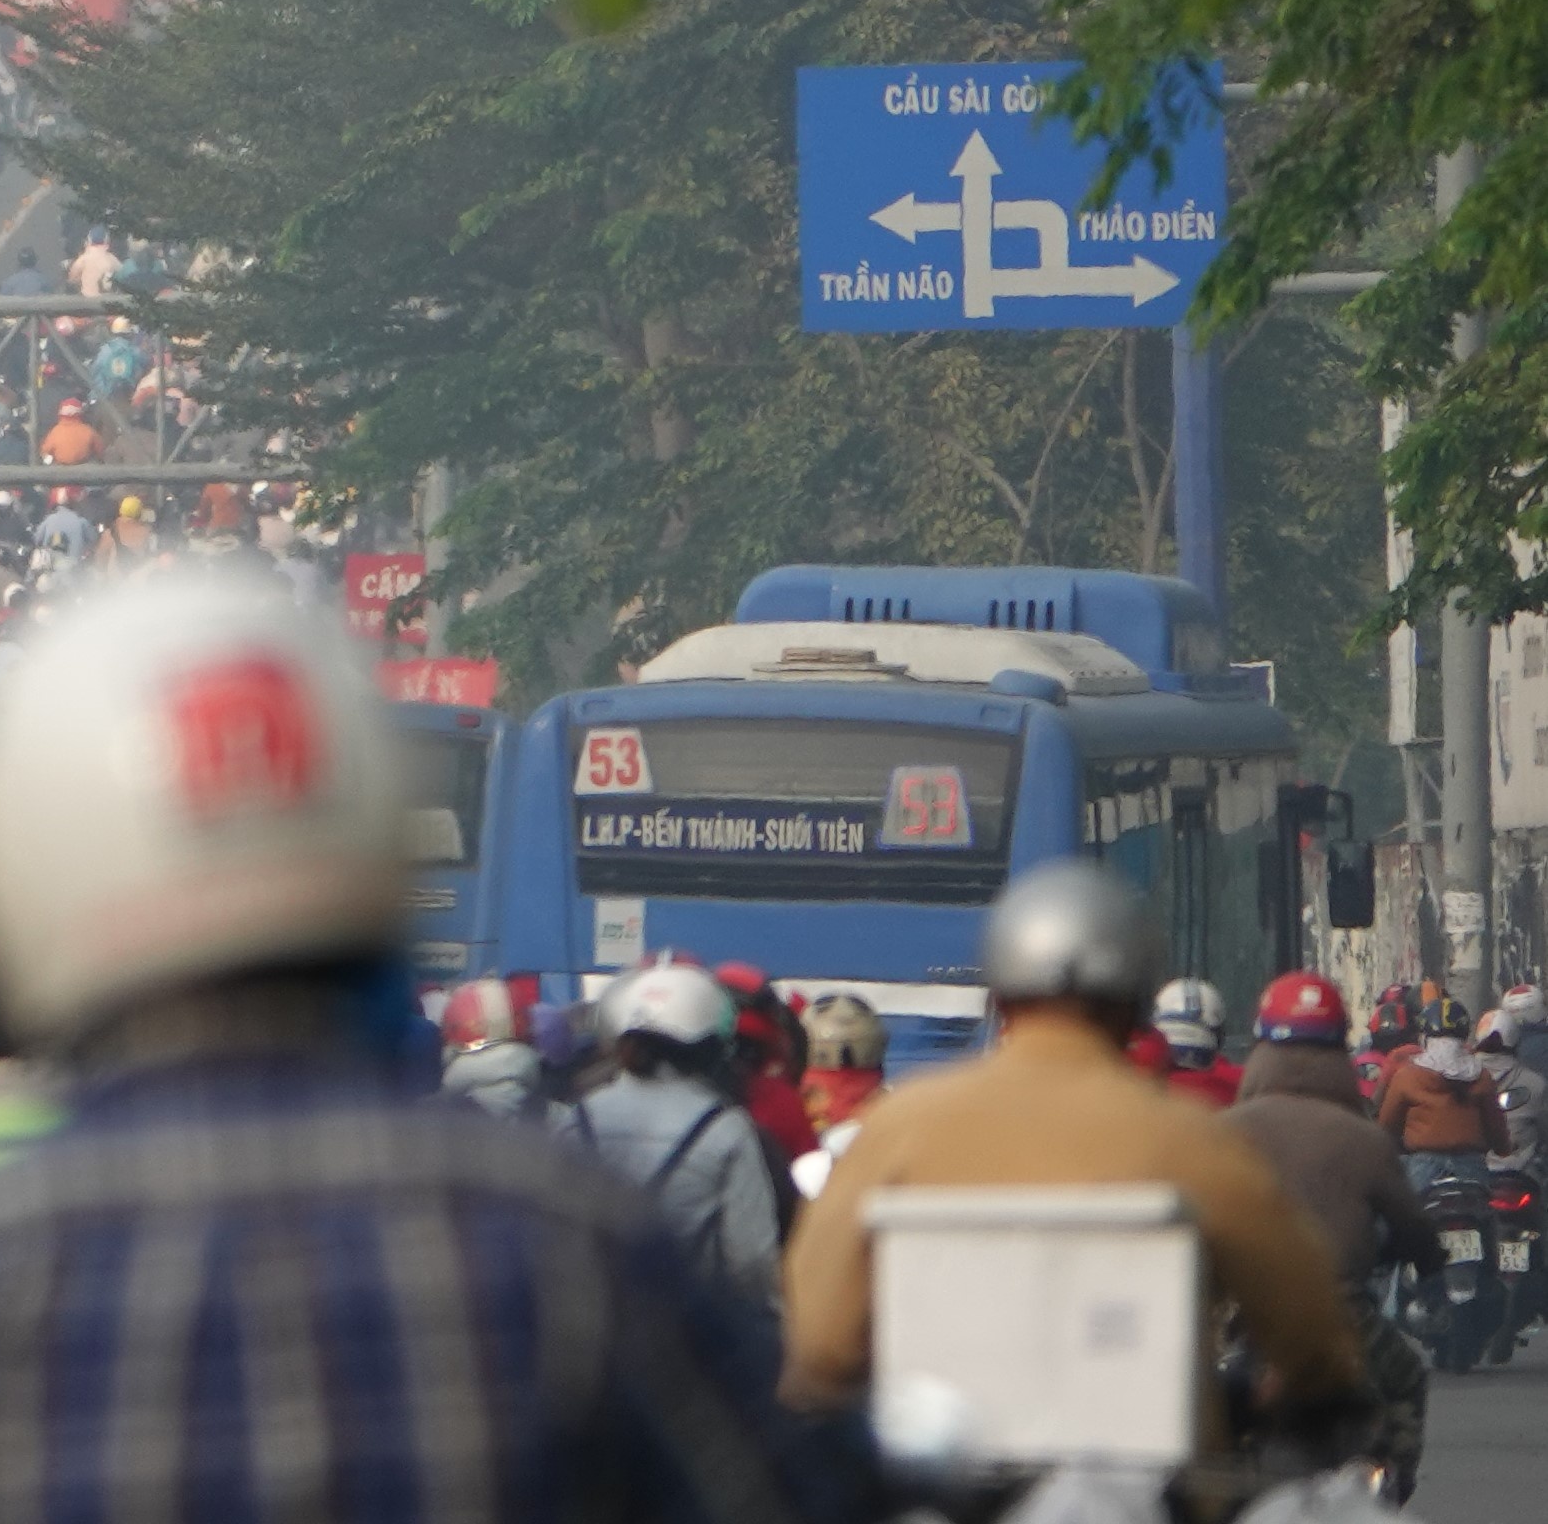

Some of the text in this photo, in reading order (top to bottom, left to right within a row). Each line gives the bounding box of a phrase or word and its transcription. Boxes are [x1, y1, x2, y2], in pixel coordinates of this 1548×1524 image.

[948, 77, 991, 114] SÀI
[819, 260, 954, 302] TRẦN NÃO
[589, 737, 641, 787] 53
[903, 778, 957, 836] 53
[817, 816, 864, 853] TIÊN
